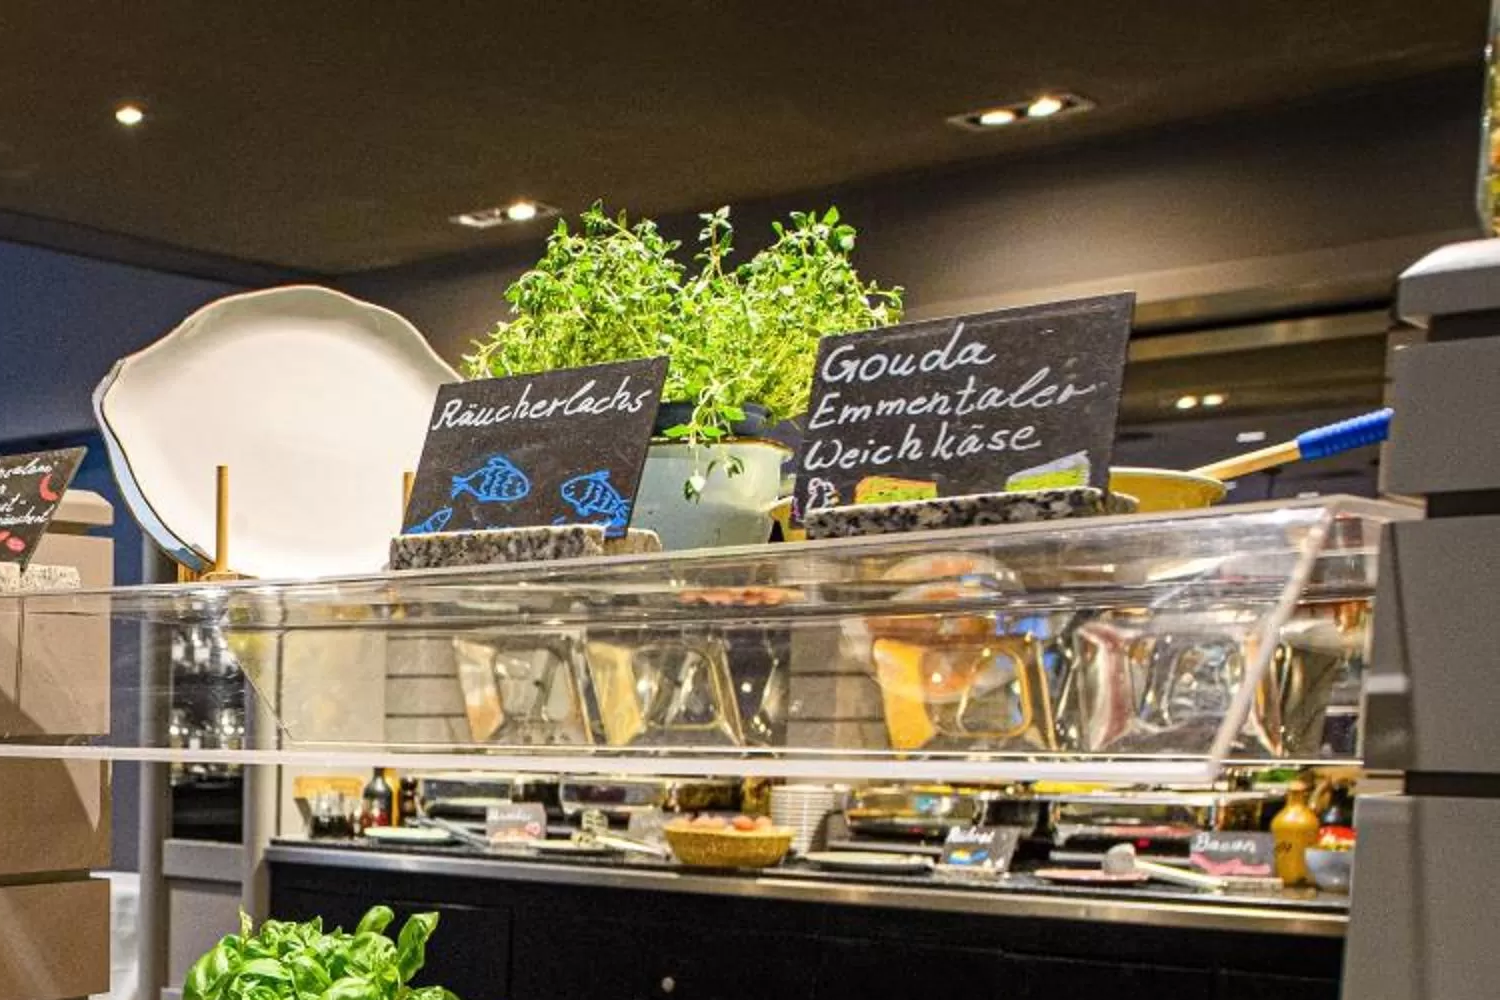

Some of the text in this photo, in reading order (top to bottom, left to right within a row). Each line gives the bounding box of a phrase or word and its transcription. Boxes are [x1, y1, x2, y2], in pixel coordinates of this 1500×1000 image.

[821, 321, 997, 383] Gouda
[432, 376, 652, 430] Räucherlachs
[808, 367, 1100, 430] Emmentaler
[803, 421, 1042, 472] Weichkäse
